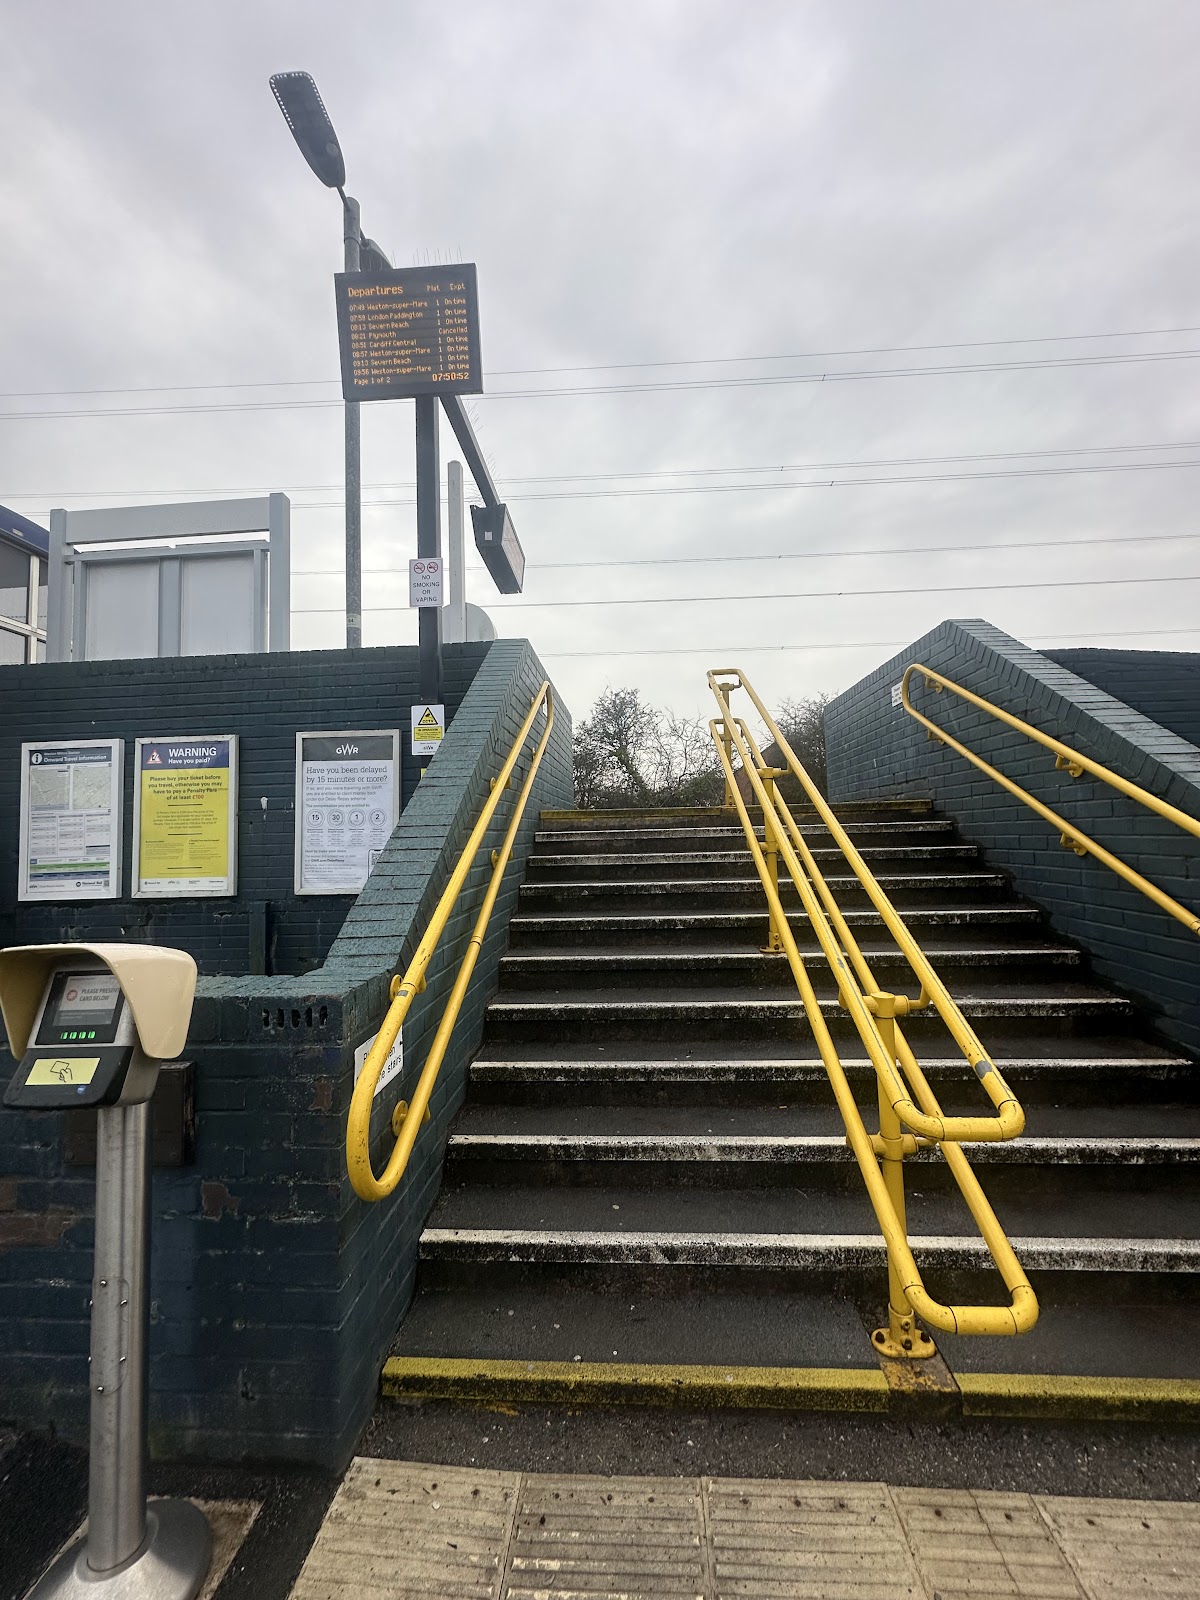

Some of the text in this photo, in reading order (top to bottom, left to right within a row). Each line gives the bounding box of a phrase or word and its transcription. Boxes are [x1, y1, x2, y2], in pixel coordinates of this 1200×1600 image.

[348, 286, 404, 298] Departures
[450, 282, 466, 290] Expt
[366, 300, 428, 310] Weston-super-Mare
[390, 311, 423, 320] Paddington
[369, 331, 397, 340] Plymouth
[370, 348, 431, 357] Weston-super-Mare
[371, 365, 432, 375] Weston-super-Mare
[432, 372, 470, 381] 07:50:52
[169, 747, 217, 757] WARNING
[336, 743, 358, 755] GWR
[361, 766, 387, 774] delayed
[388, 1054, 402, 1073] stairs
